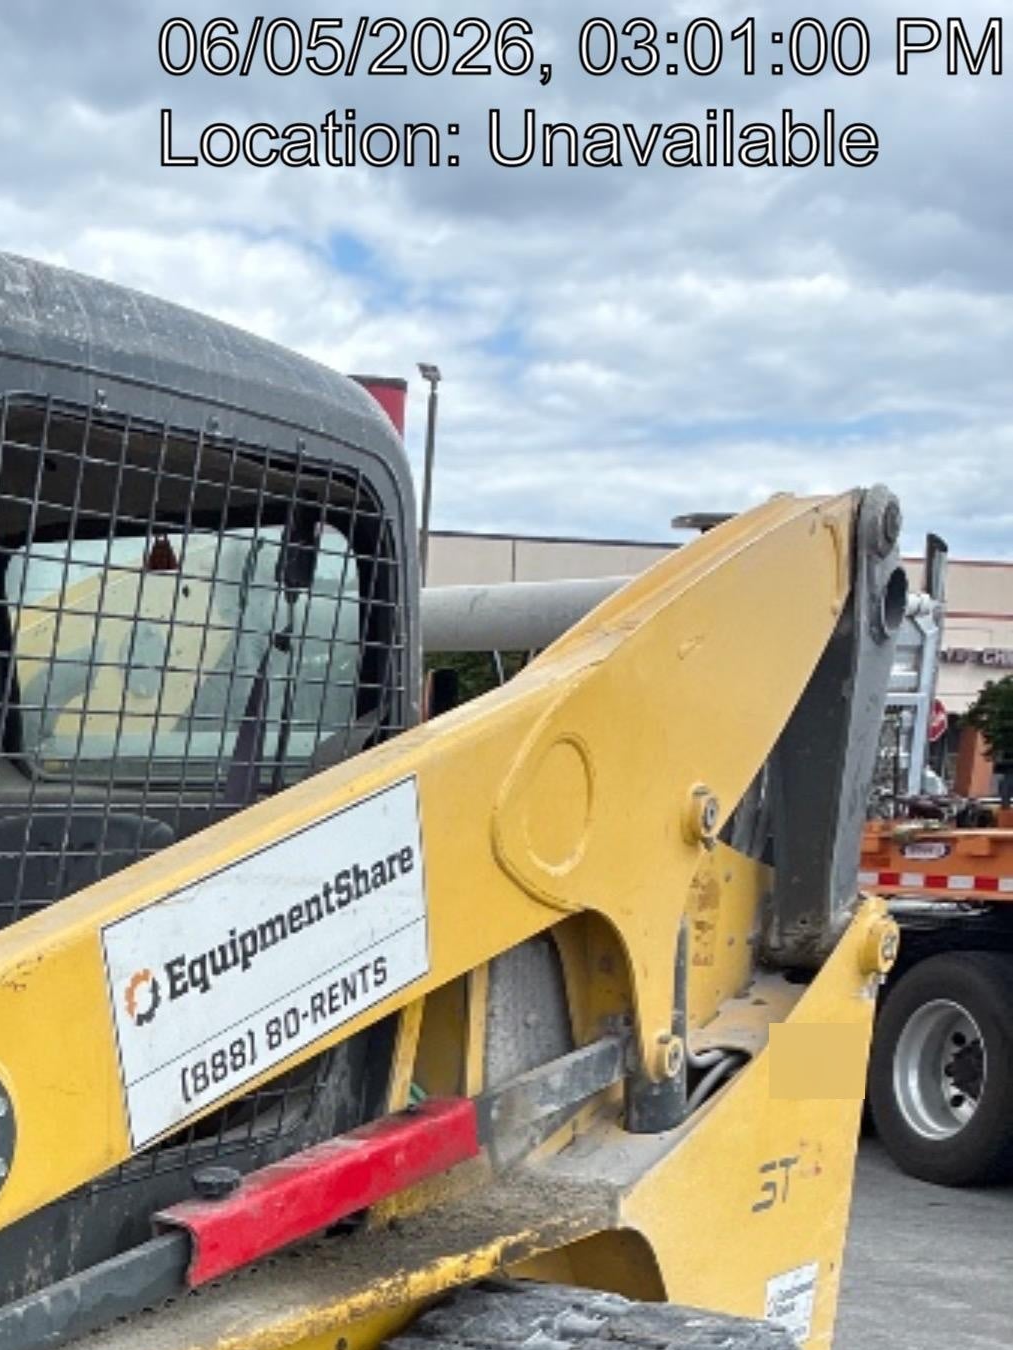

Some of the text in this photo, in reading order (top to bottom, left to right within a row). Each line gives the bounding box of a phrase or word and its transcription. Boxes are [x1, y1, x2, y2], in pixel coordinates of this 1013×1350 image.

[164, 846, 415, 1003] EquipmentShare
[180, 956, 389, 1104] (888) 80-RENTS
